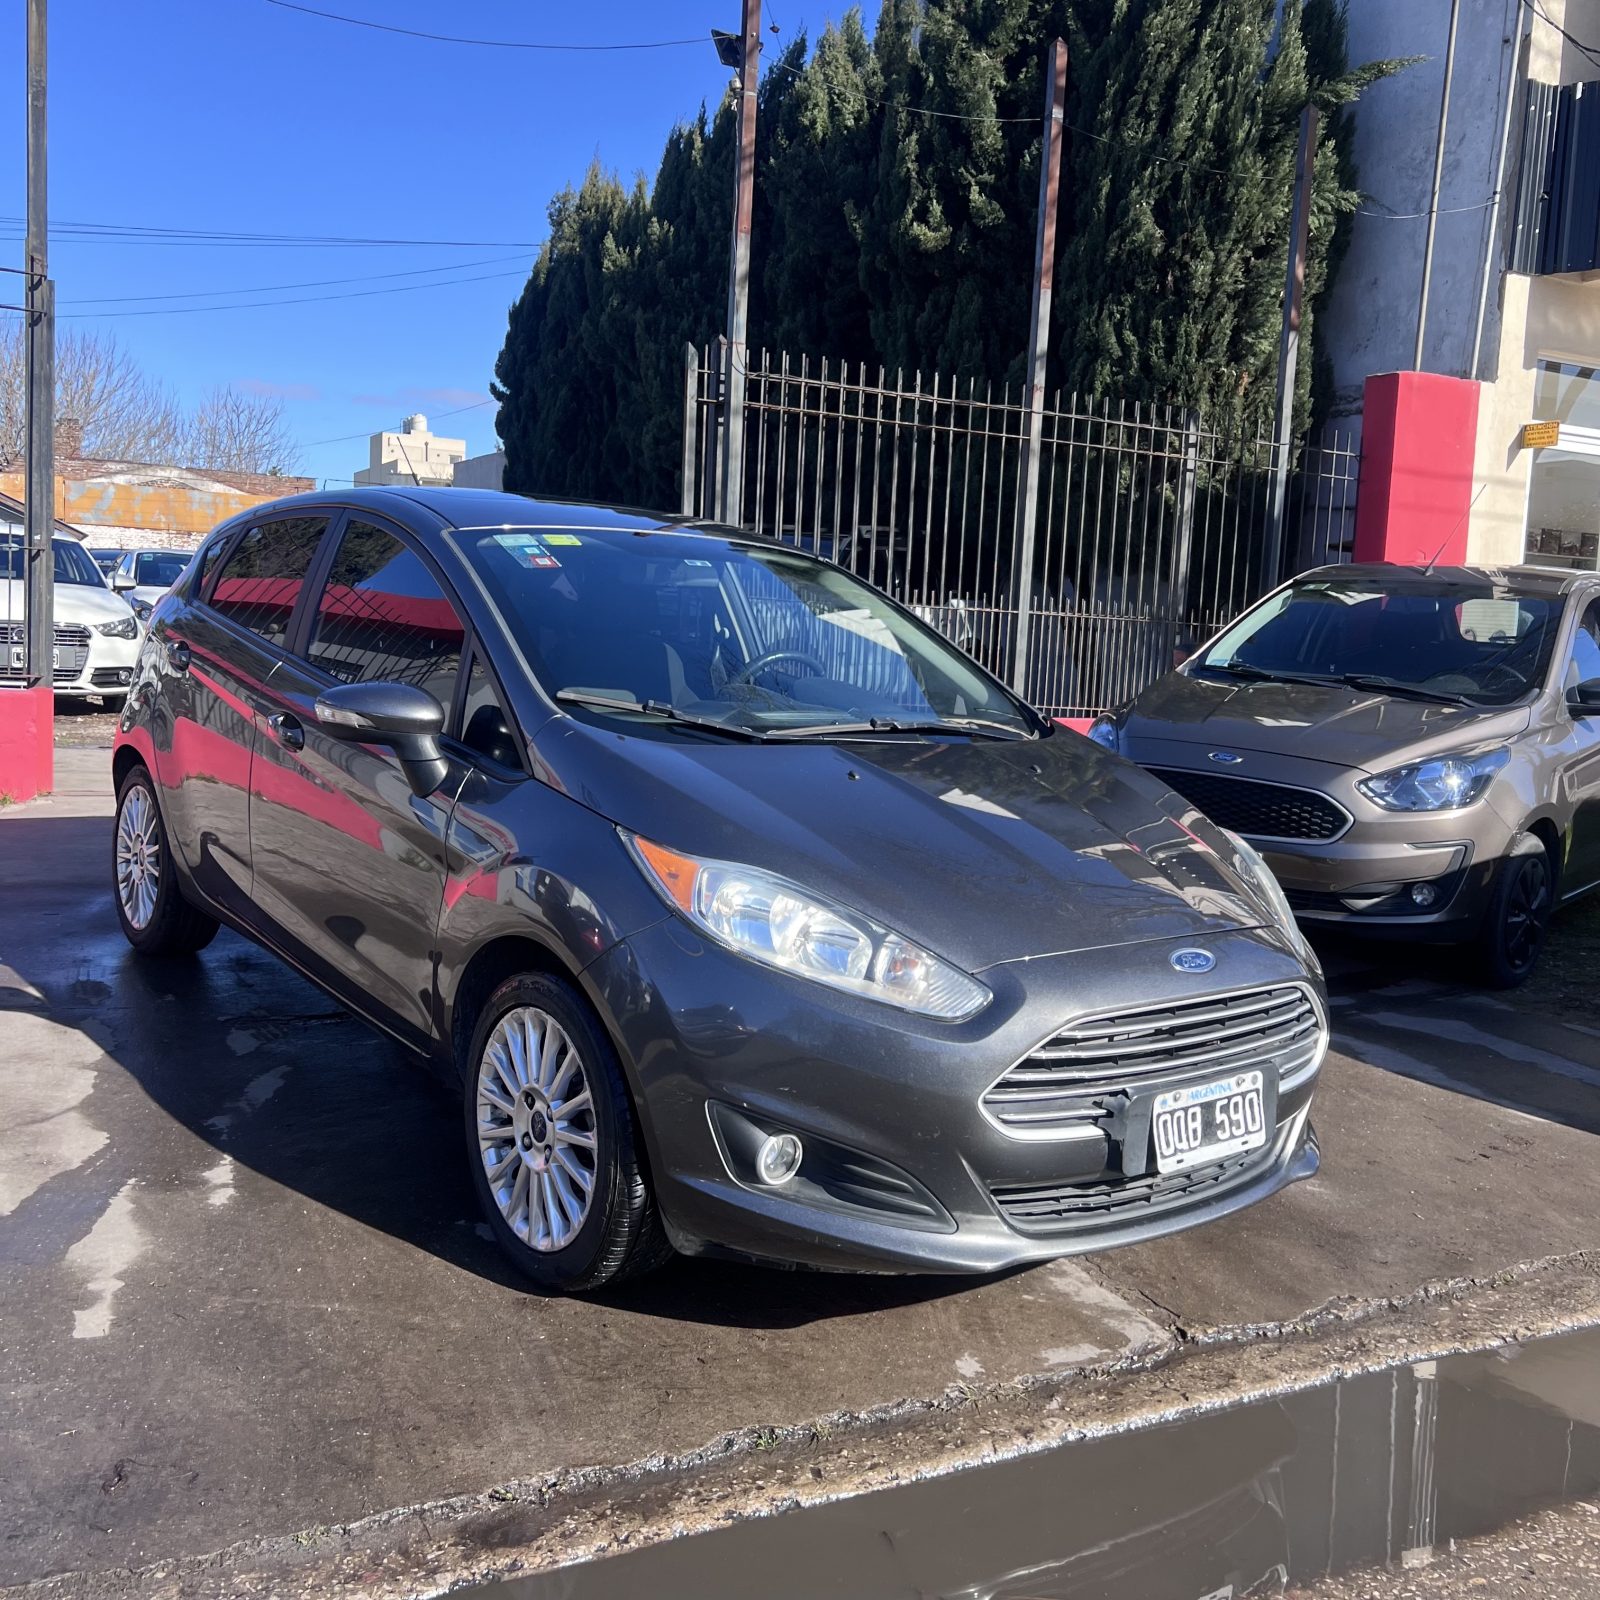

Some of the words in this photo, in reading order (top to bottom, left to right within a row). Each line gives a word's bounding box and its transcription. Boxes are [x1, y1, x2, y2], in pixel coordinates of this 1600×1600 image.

[1180, 952, 1207, 968] Ford
[1189, 1082, 1232, 1101] ARGENTINA
[1215, 1091, 1261, 1140] 590
